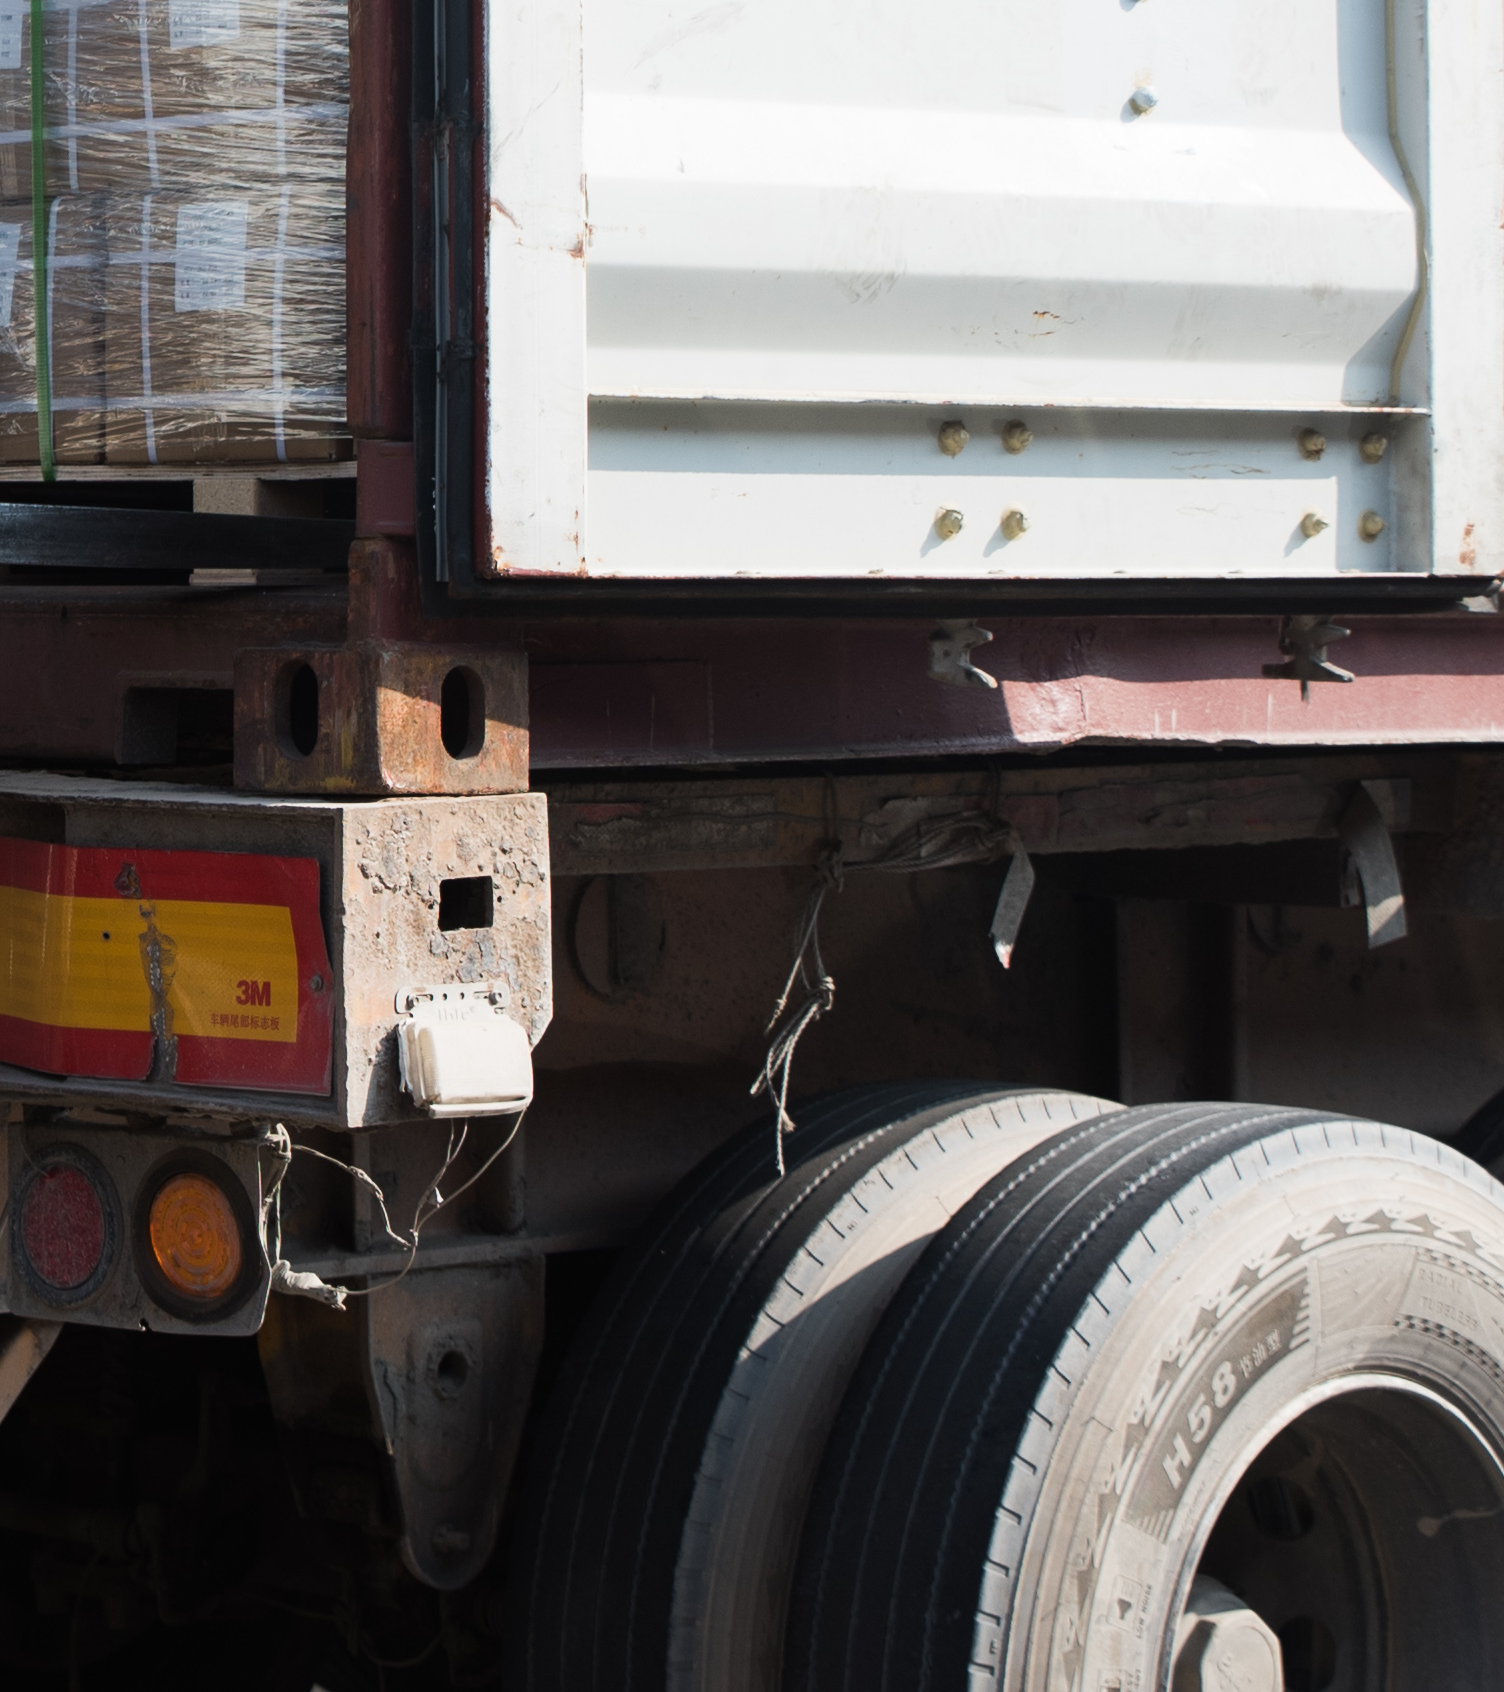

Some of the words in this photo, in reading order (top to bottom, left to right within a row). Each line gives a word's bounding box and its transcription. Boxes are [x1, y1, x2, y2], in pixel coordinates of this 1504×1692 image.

[235, 979, 271, 1007] 3M
[210, 1012, 280, 1031] 车辆尾部标志板
